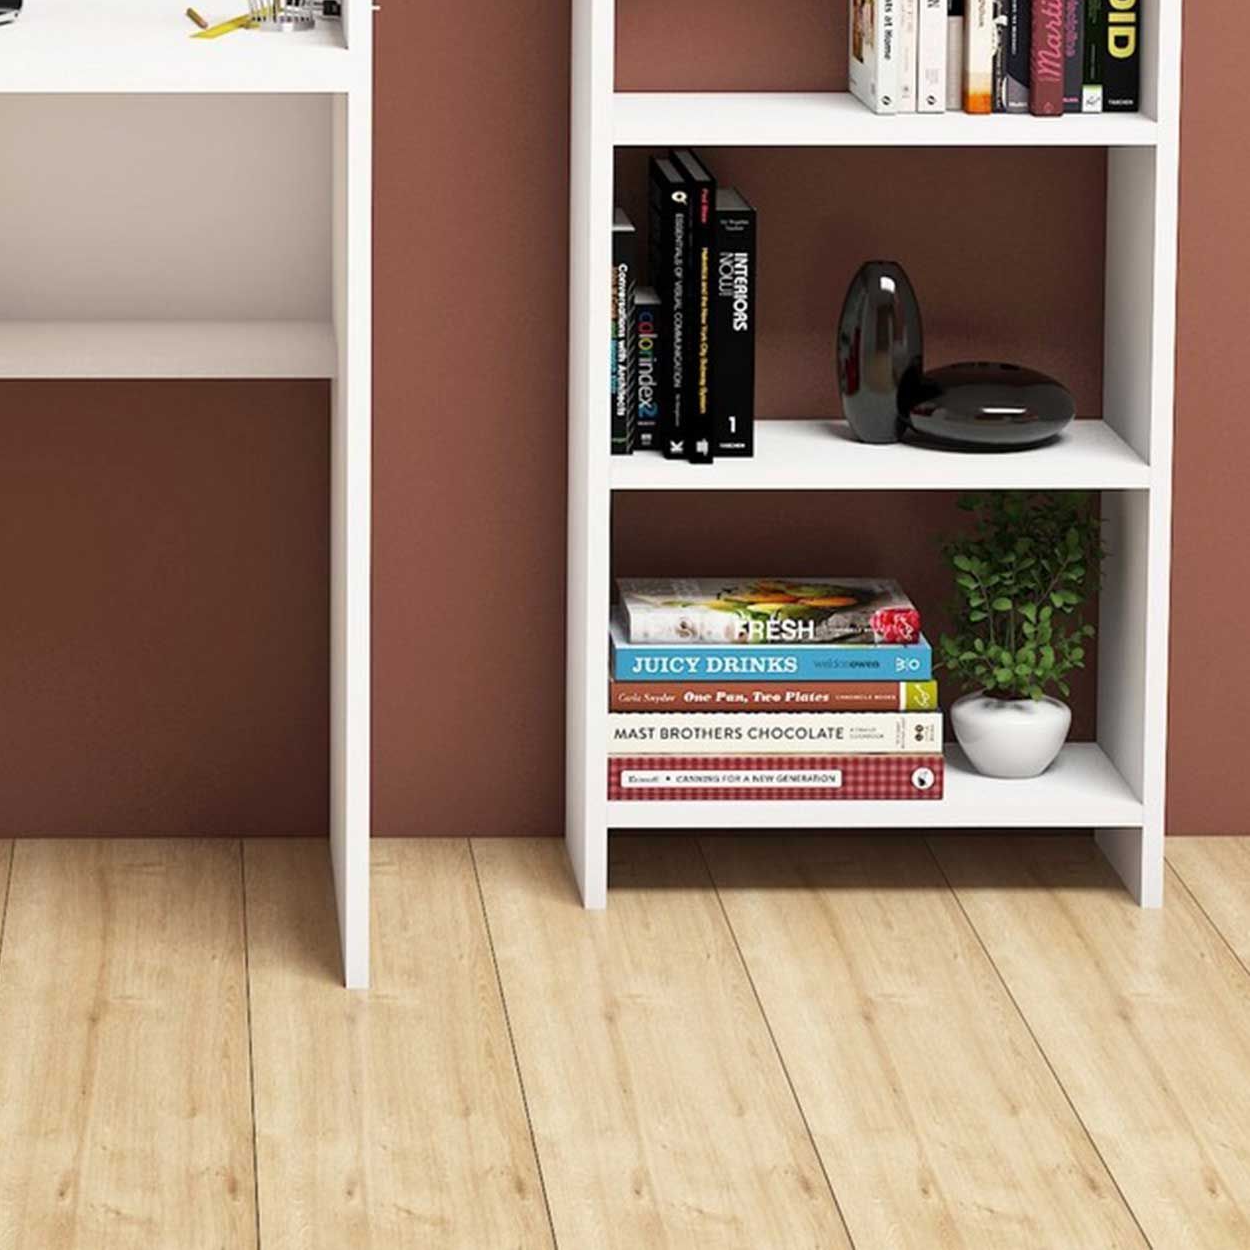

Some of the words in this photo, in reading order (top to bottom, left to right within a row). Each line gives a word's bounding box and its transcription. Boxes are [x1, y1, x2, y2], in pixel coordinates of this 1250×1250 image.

[885, 16, 893, 27] at
[883, 29, 892, 60] Home
[673, 213, 684, 265] ESSENTIALS
[674, 267, 684, 278] OF
[718, 252, 734, 297] NOW!
[618, 263, 628, 338] Conversations
[673, 280, 683, 311] VISUAL
[733, 252, 748, 331] INTERIORS
[618, 340, 628, 362] with
[672, 312, 683, 388] COMMUNICATION
[617, 365, 627, 416] Architects
[728, 415, 736, 433] 1
[734, 620, 815, 641] FRESH
[632, 656, 701, 673] JUICY
[706, 656, 798, 673] DRINKS
[683, 691, 712, 703] One
[715, 691, 748, 703] Pan,
[752, 692, 781, 703] Two
[784, 690, 830, 702] Plates
[613, 727, 656, 741] MAST
[660, 727, 743, 741] BROTHERS
[747, 727, 845, 741] CHOCOLATE
[721, 775, 742, 783] FOR
[743, 775, 751, 783] A
[752, 775, 774, 783] NEW
[776, 773, 837, 783] GENERATION
